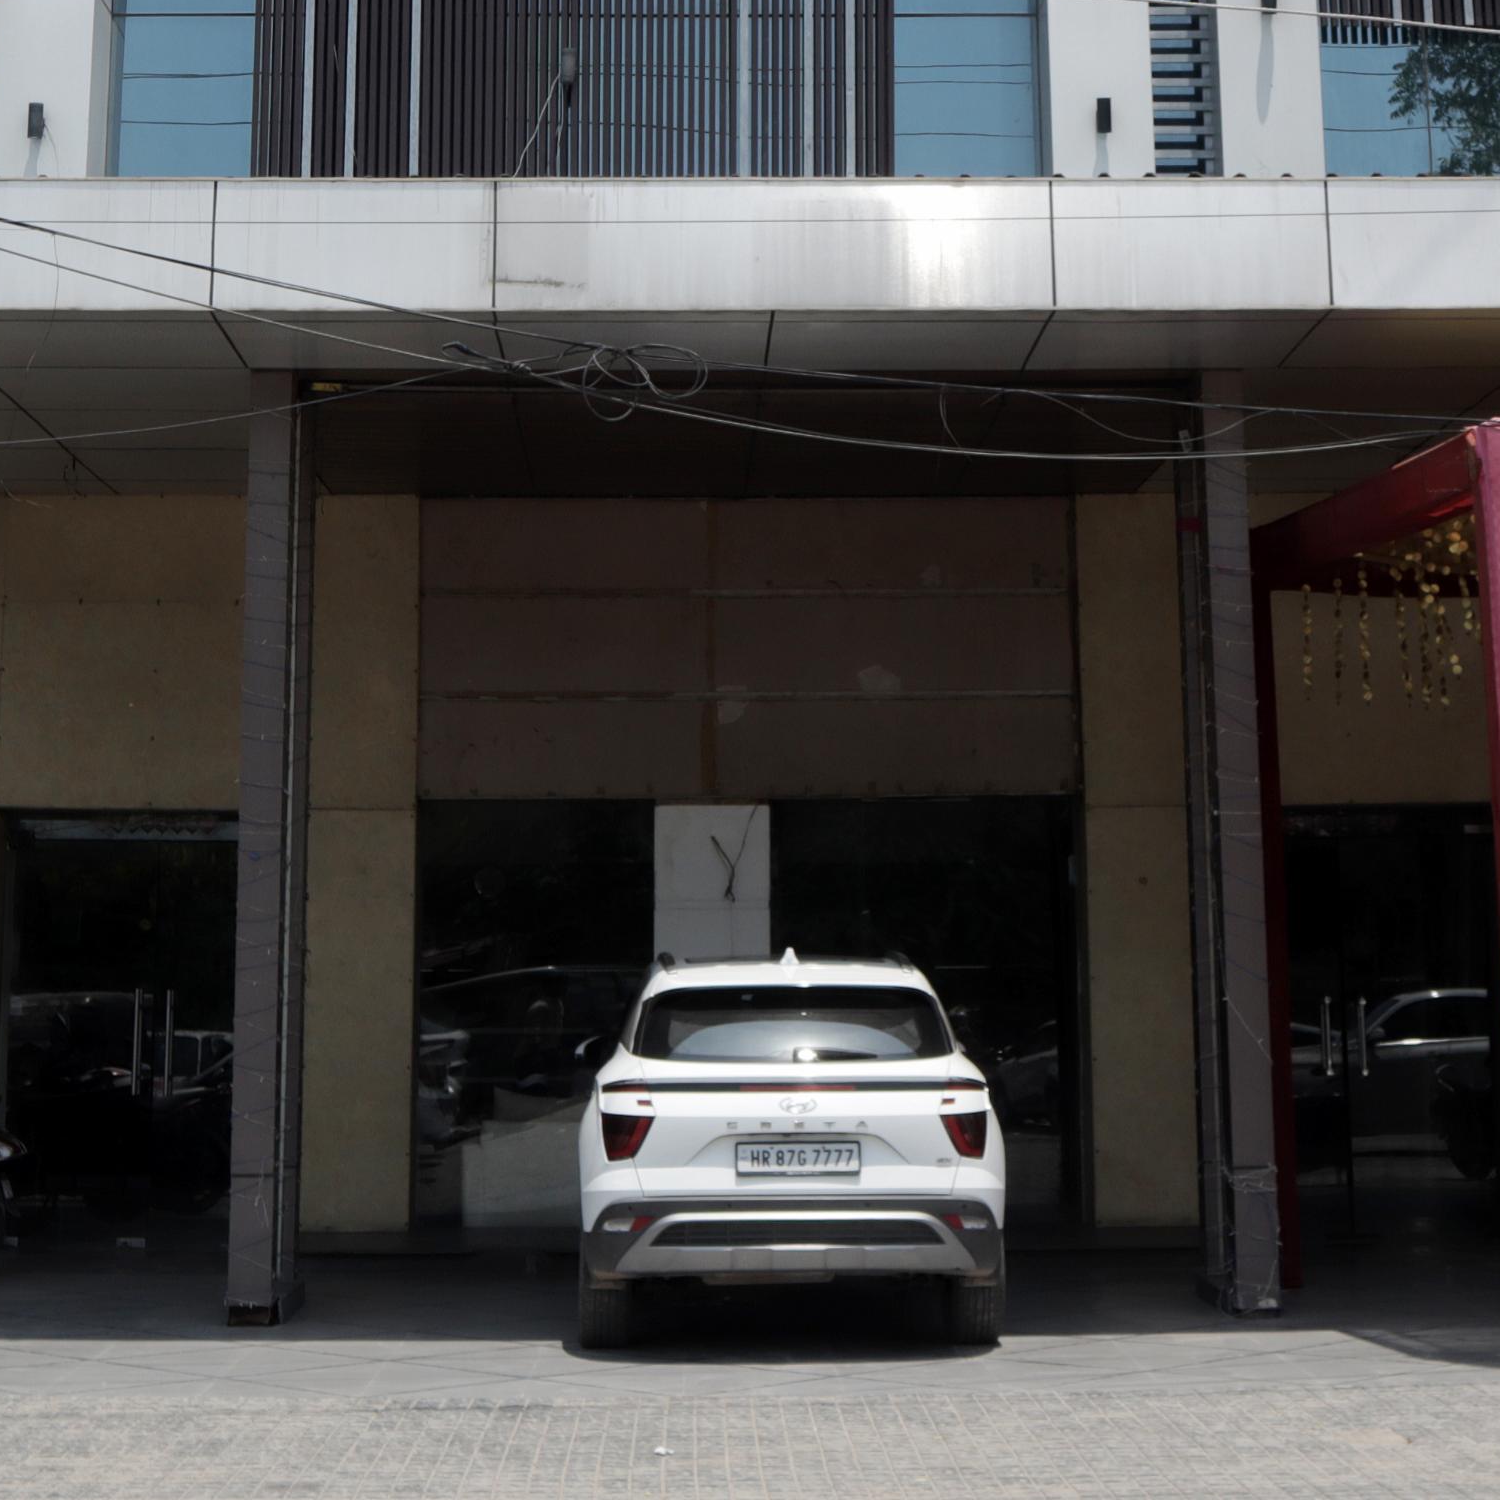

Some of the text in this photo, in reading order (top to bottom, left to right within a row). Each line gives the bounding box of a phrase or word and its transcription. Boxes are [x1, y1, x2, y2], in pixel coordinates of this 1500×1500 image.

[726, 1119, 869, 1131] CRETA
[750, 1149, 771, 1167] HR
[811, 1148, 855, 1168] 7777
